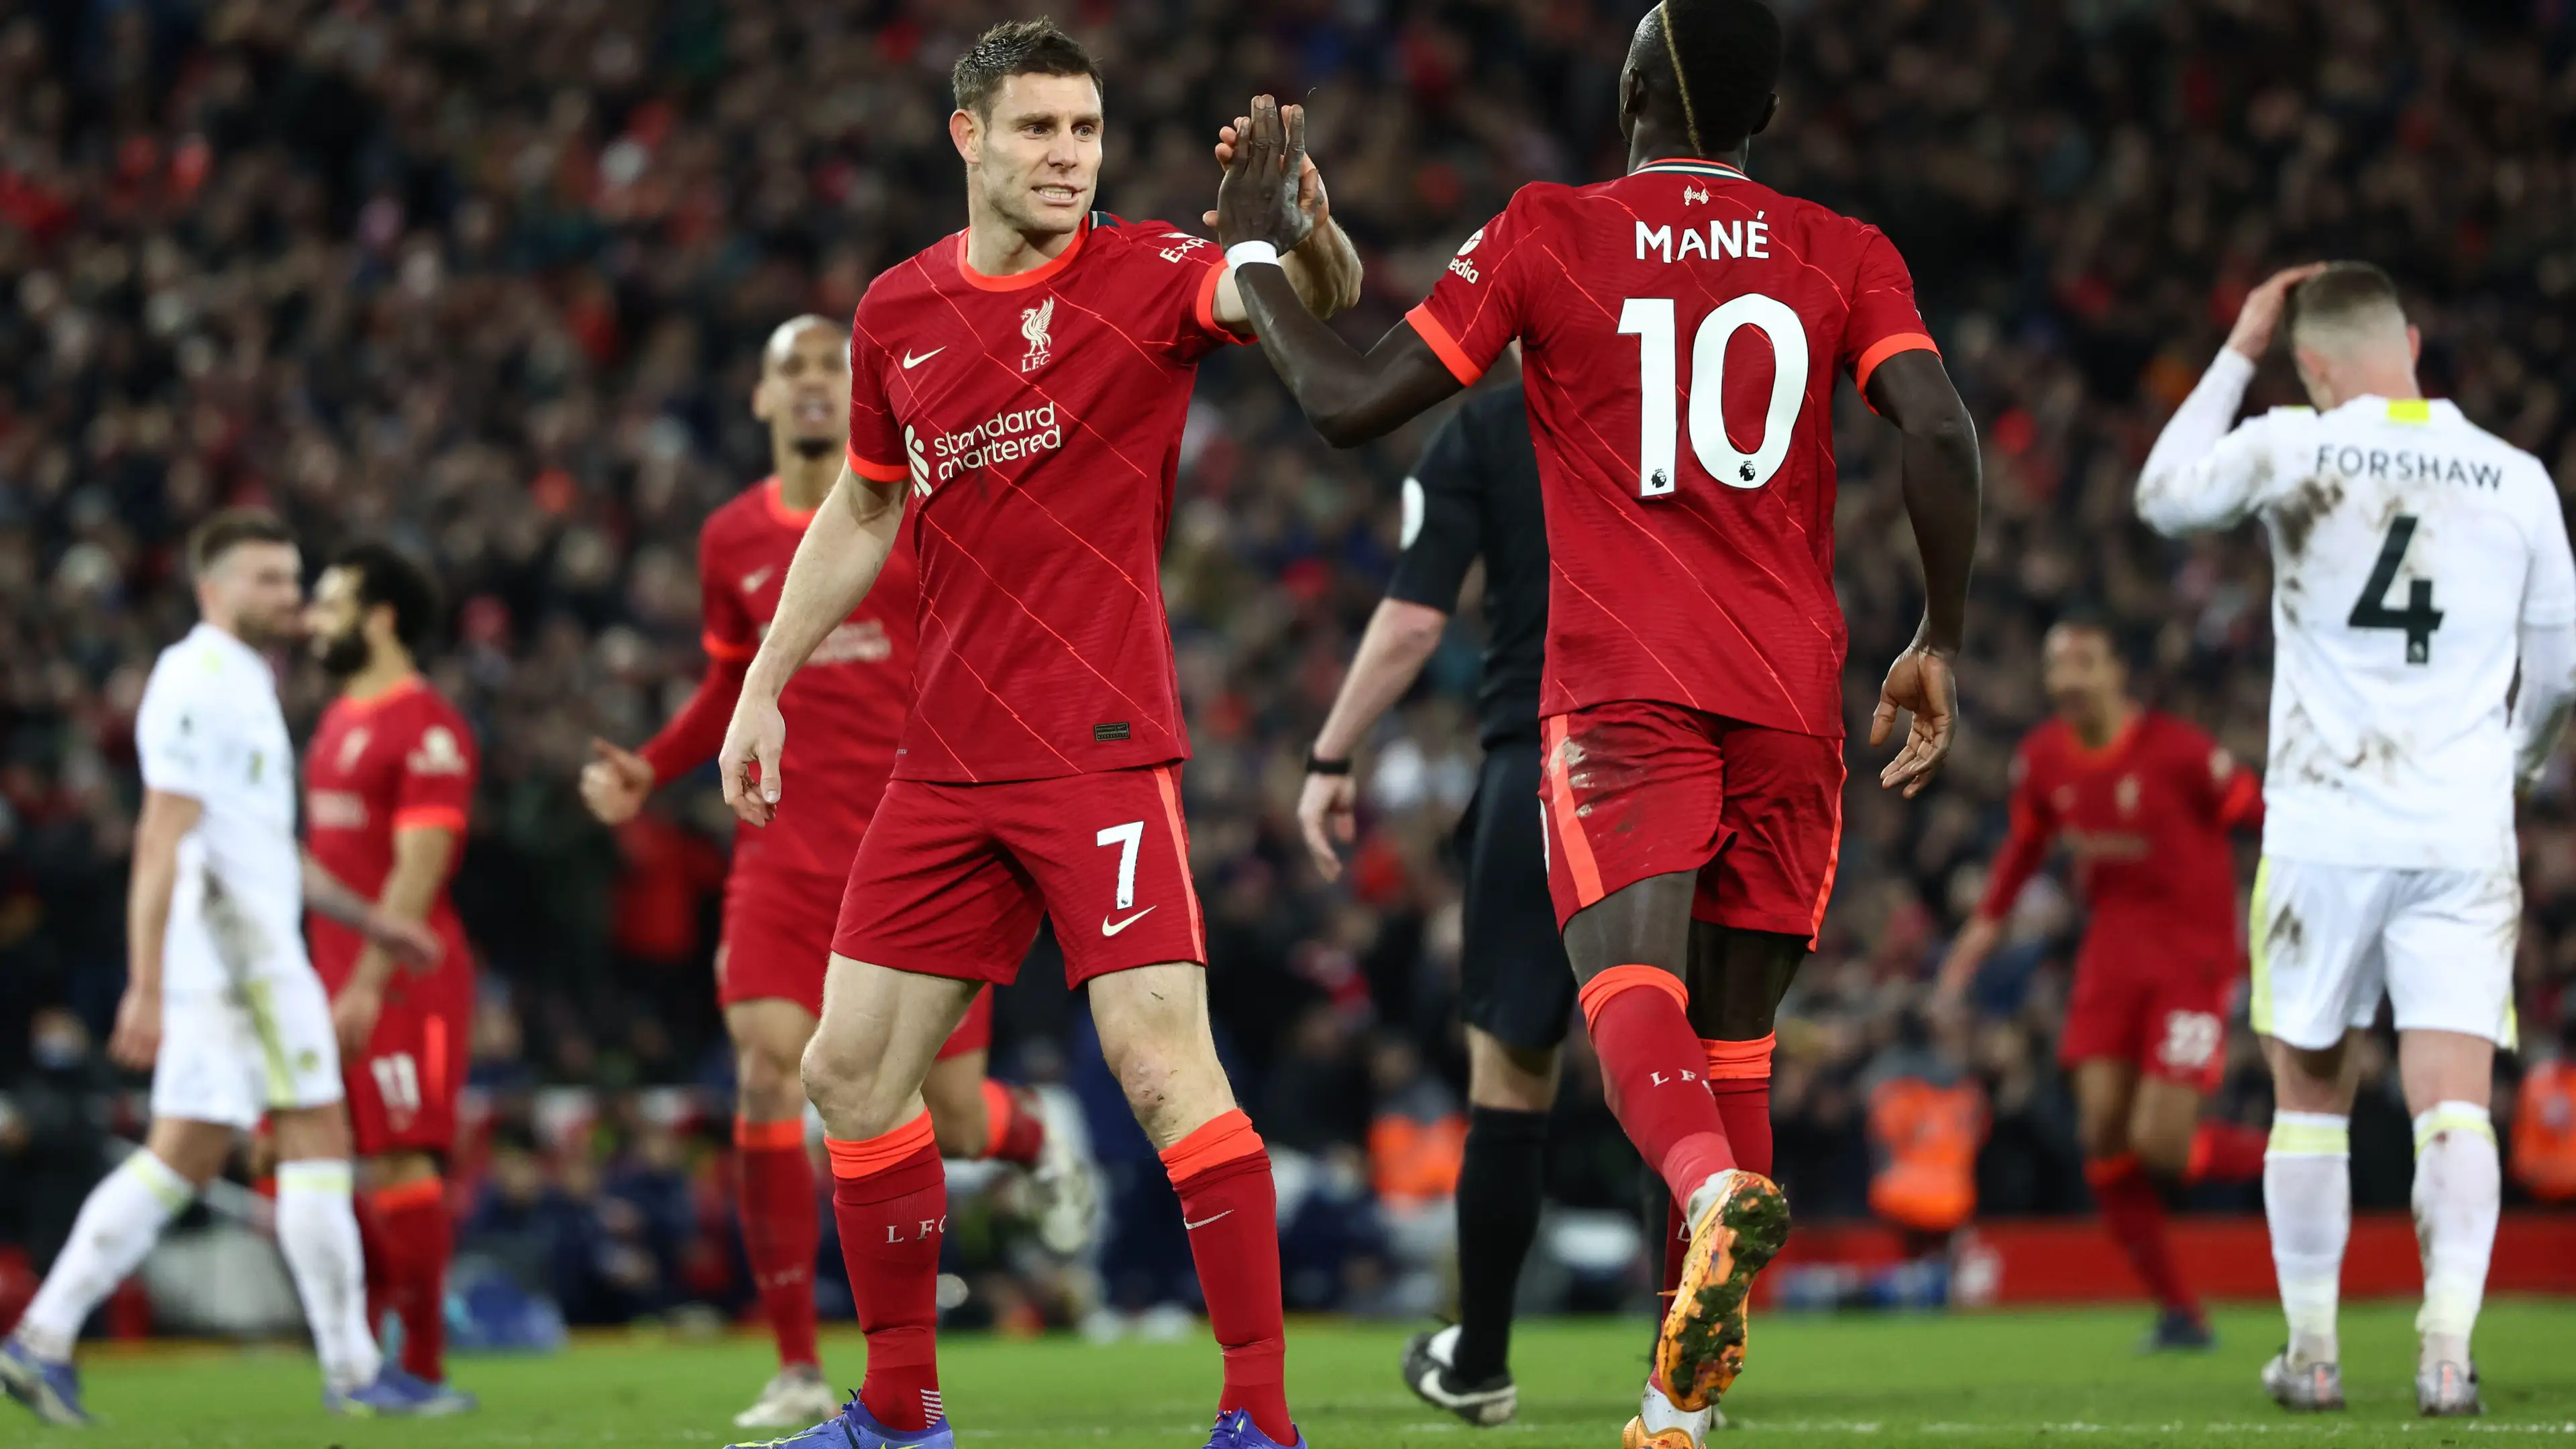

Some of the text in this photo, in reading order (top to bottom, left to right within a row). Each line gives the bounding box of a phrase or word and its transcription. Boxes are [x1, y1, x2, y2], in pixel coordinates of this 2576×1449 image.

[1691, 191, 1702, 201] 96
[1159, 237, 1214, 264] Exp
[1635, 210, 1770, 264] MANÉ
[1448, 258, 1480, 284] edia
[1617, 292, 1809, 498] 10
[934, 400, 1055, 457] standard
[938, 424, 1061, 480] chartered
[2316, 443, 2502, 492] FORSHAW
[2349, 516, 2444, 663] 4
[1096, 820, 1144, 910] 7
